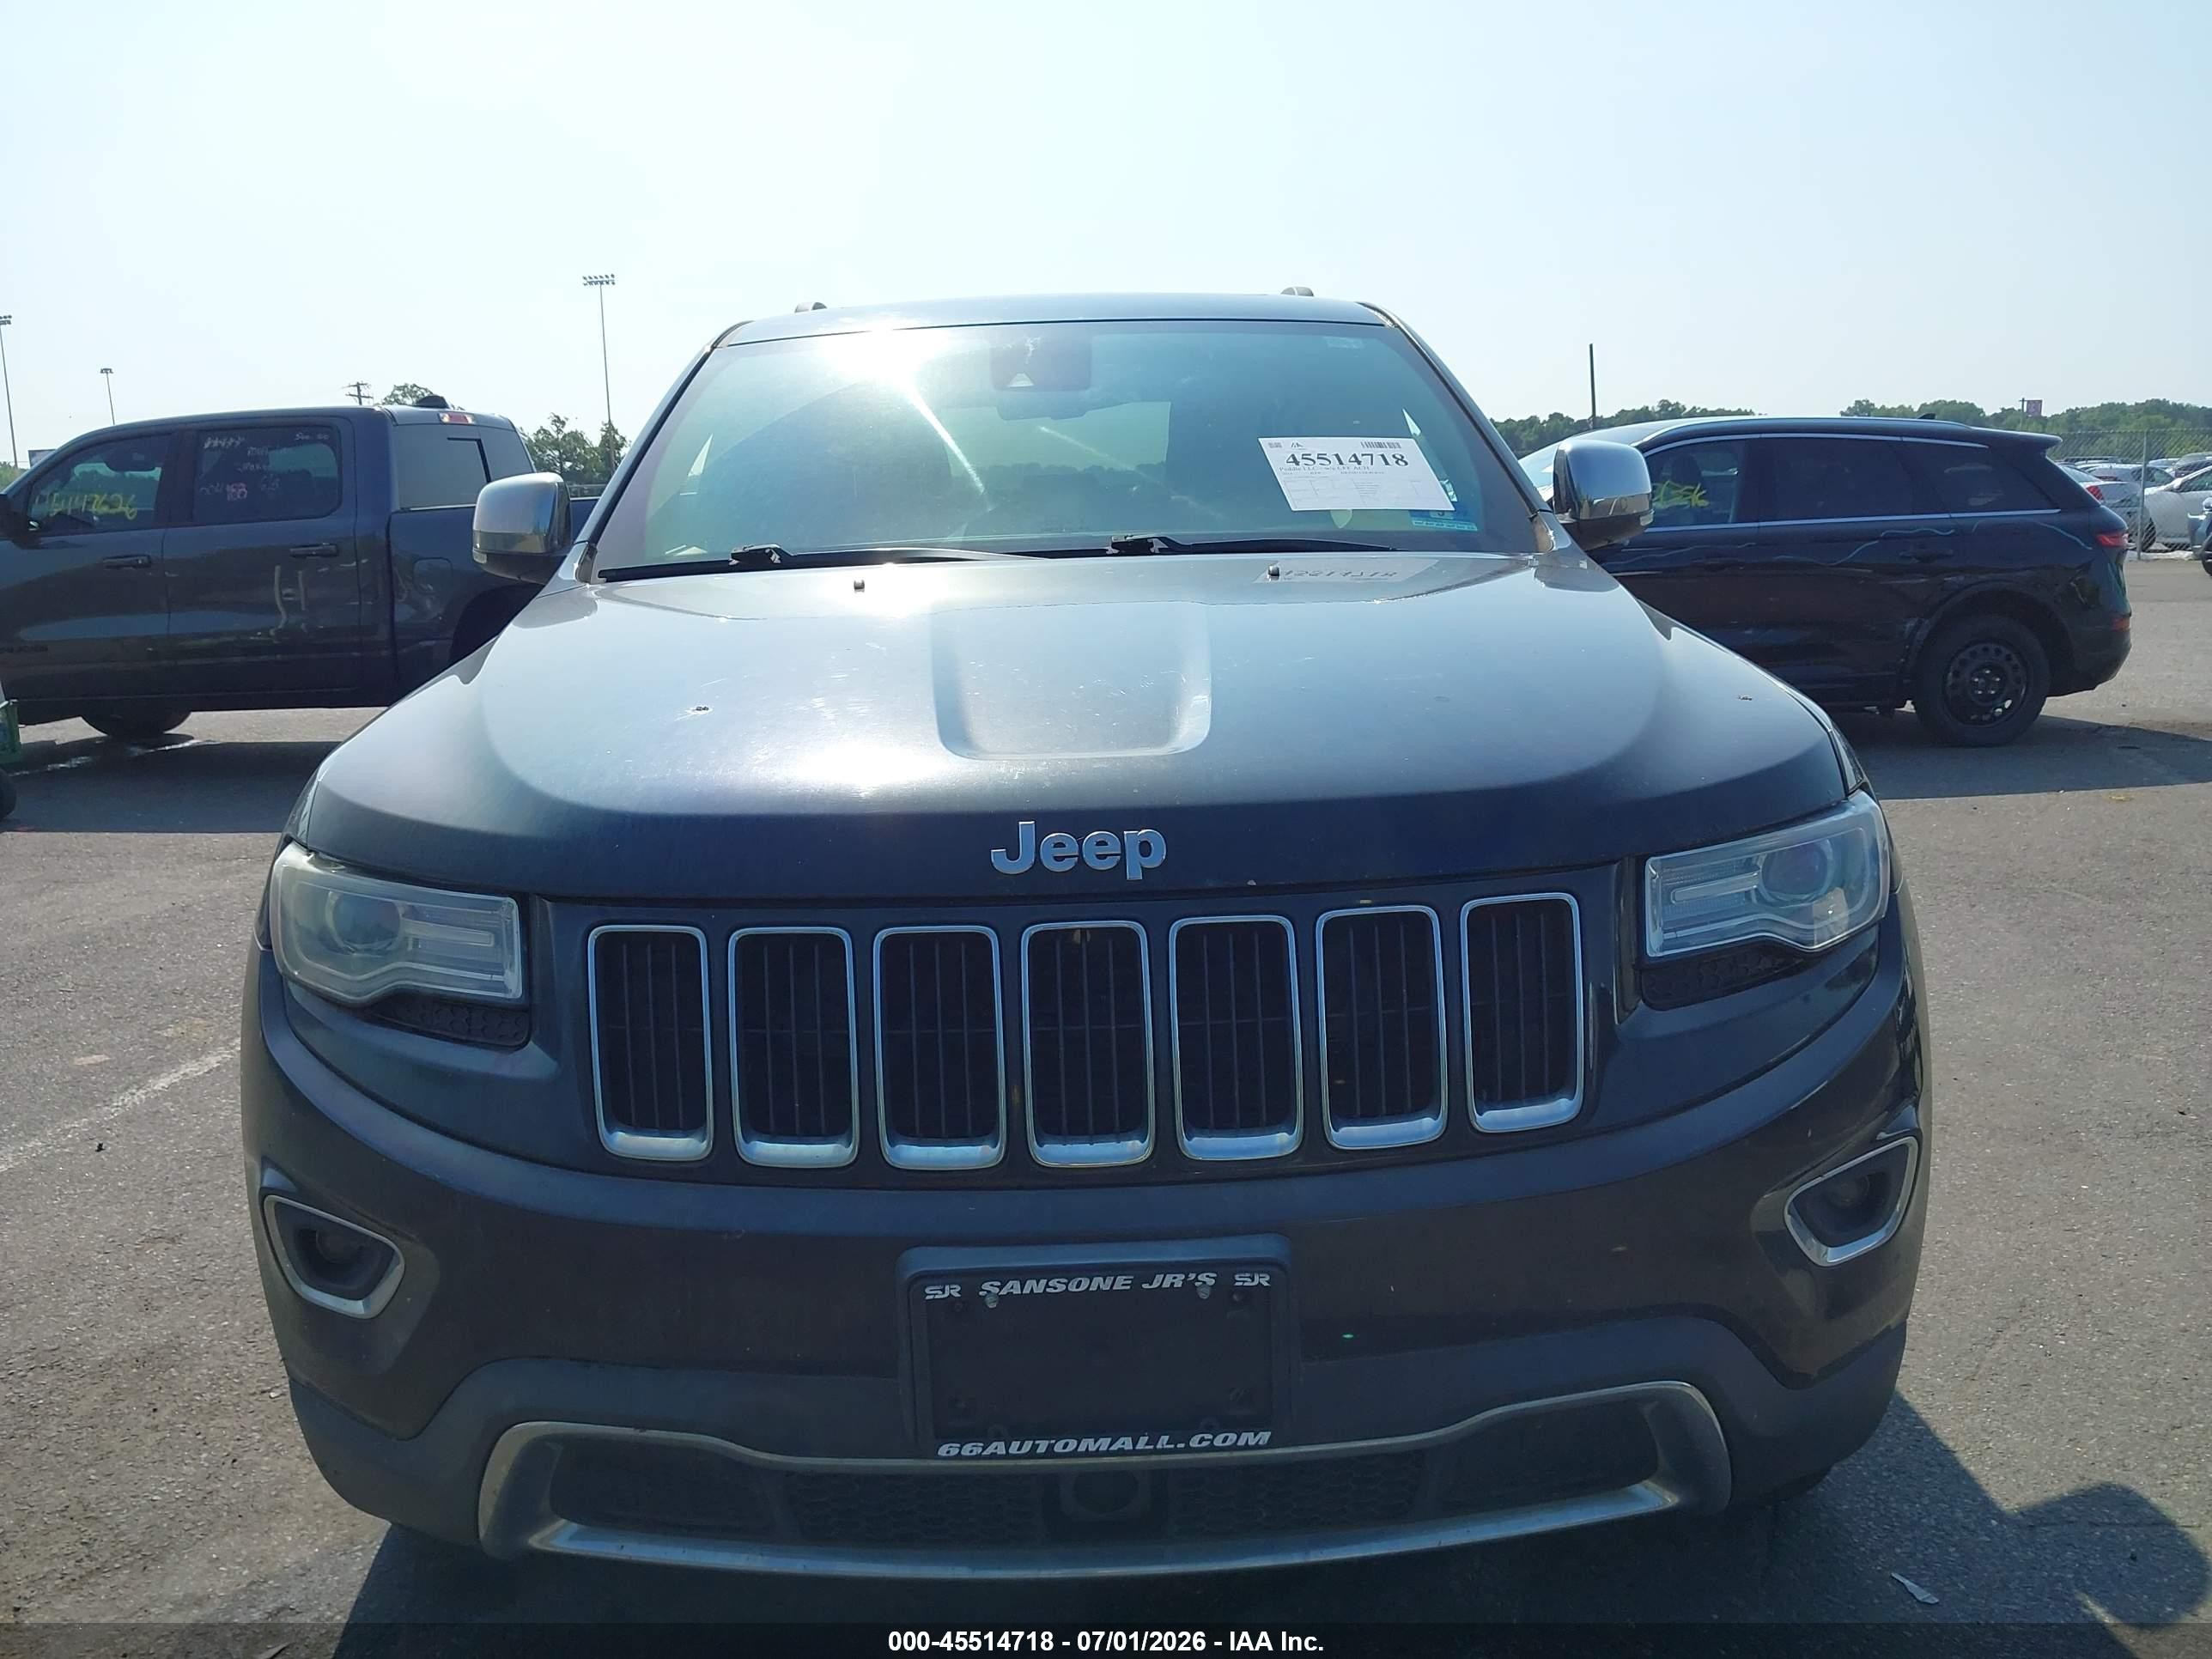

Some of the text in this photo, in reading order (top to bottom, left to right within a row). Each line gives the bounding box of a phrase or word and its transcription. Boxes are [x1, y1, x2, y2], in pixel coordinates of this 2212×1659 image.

[1286, 453, 1409, 466] 45514718
[991, 821, 1167, 880] Jeep
[979, 1273, 1218, 1297] SANSONE JR'S
[938, 1432, 1272, 1457] 66AUTOMALL.COM
